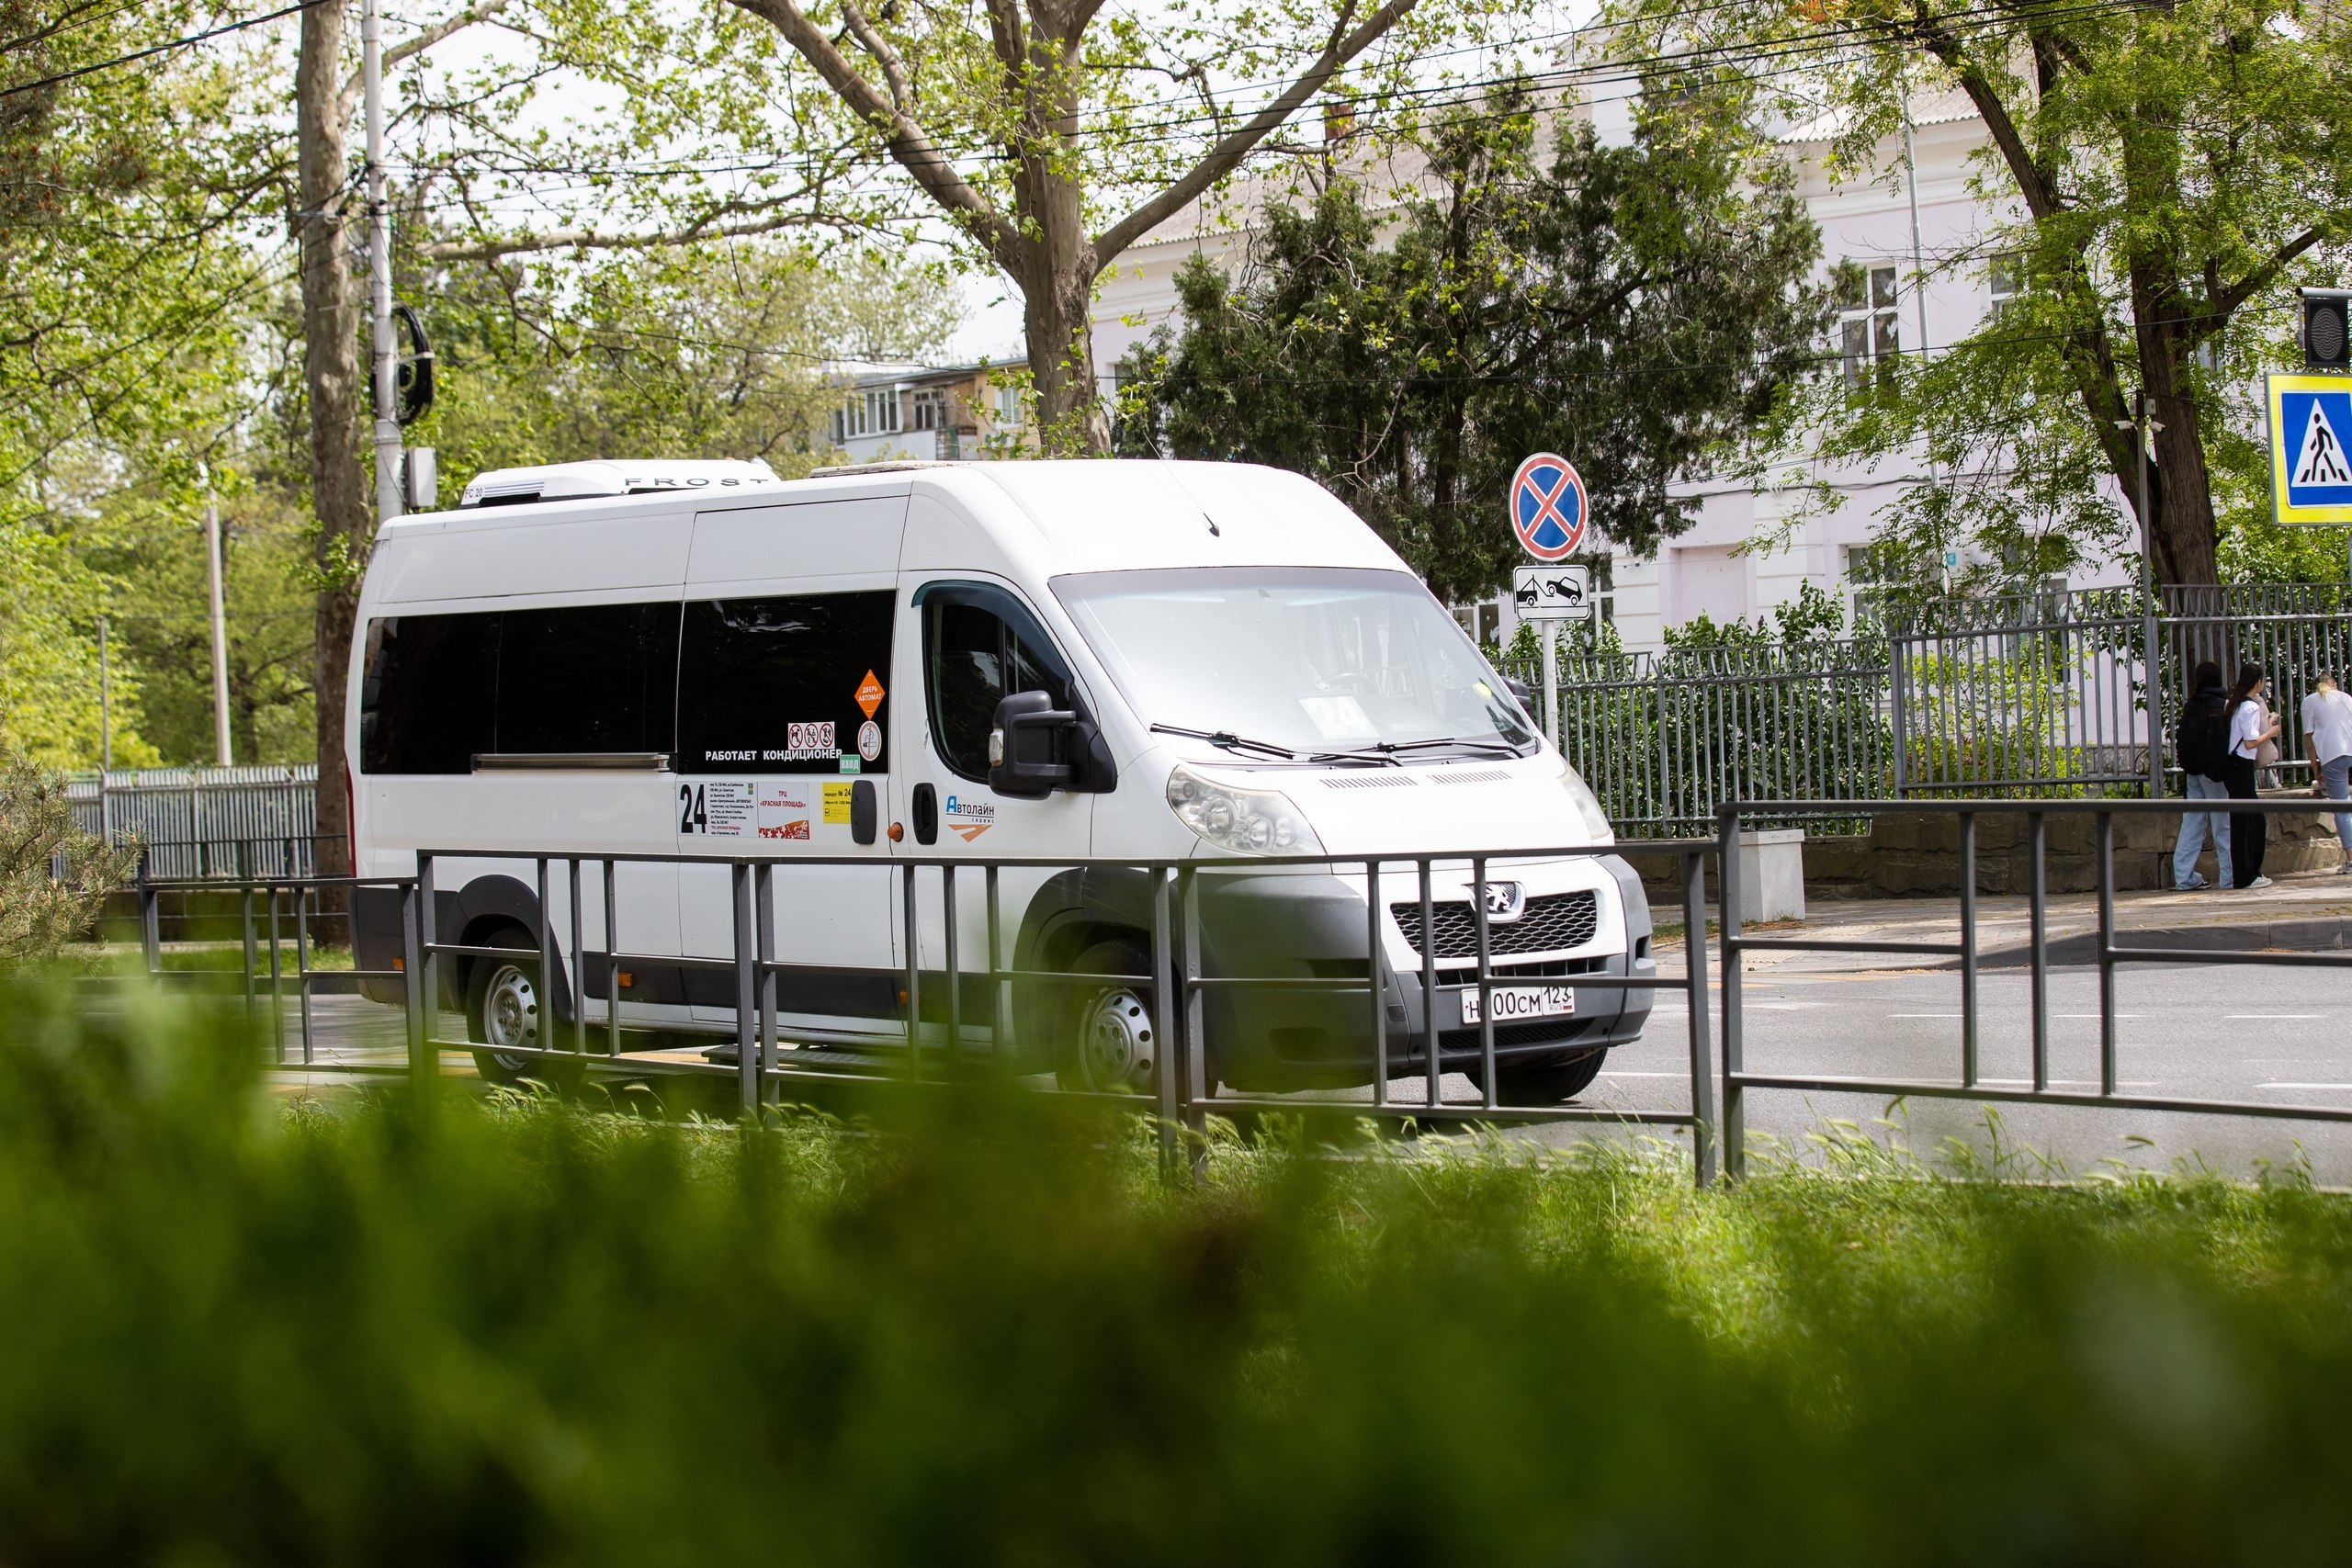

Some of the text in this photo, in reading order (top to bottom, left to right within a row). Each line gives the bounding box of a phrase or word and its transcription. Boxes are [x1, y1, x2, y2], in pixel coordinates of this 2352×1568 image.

[625, 478, 769, 486] FROST
[474, 488, 483, 497] 20
[862, 685, 877, 694] ДВЕРЬ
[858, 693, 882, 702] АВТОМАТ
[705, 749, 842, 761] РАБОТАЕТ КОНДИЦИОНЕР
[841, 760, 859, 770] ВХОД
[844, 787, 851, 797] 24
[680, 784, 707, 833] 24
[782, 800, 807, 808] ПЛОЩАДЬ»
[946, 795, 994, 816] Автолайн
[1469, 987, 1570, 1015] Н00СМ 123
